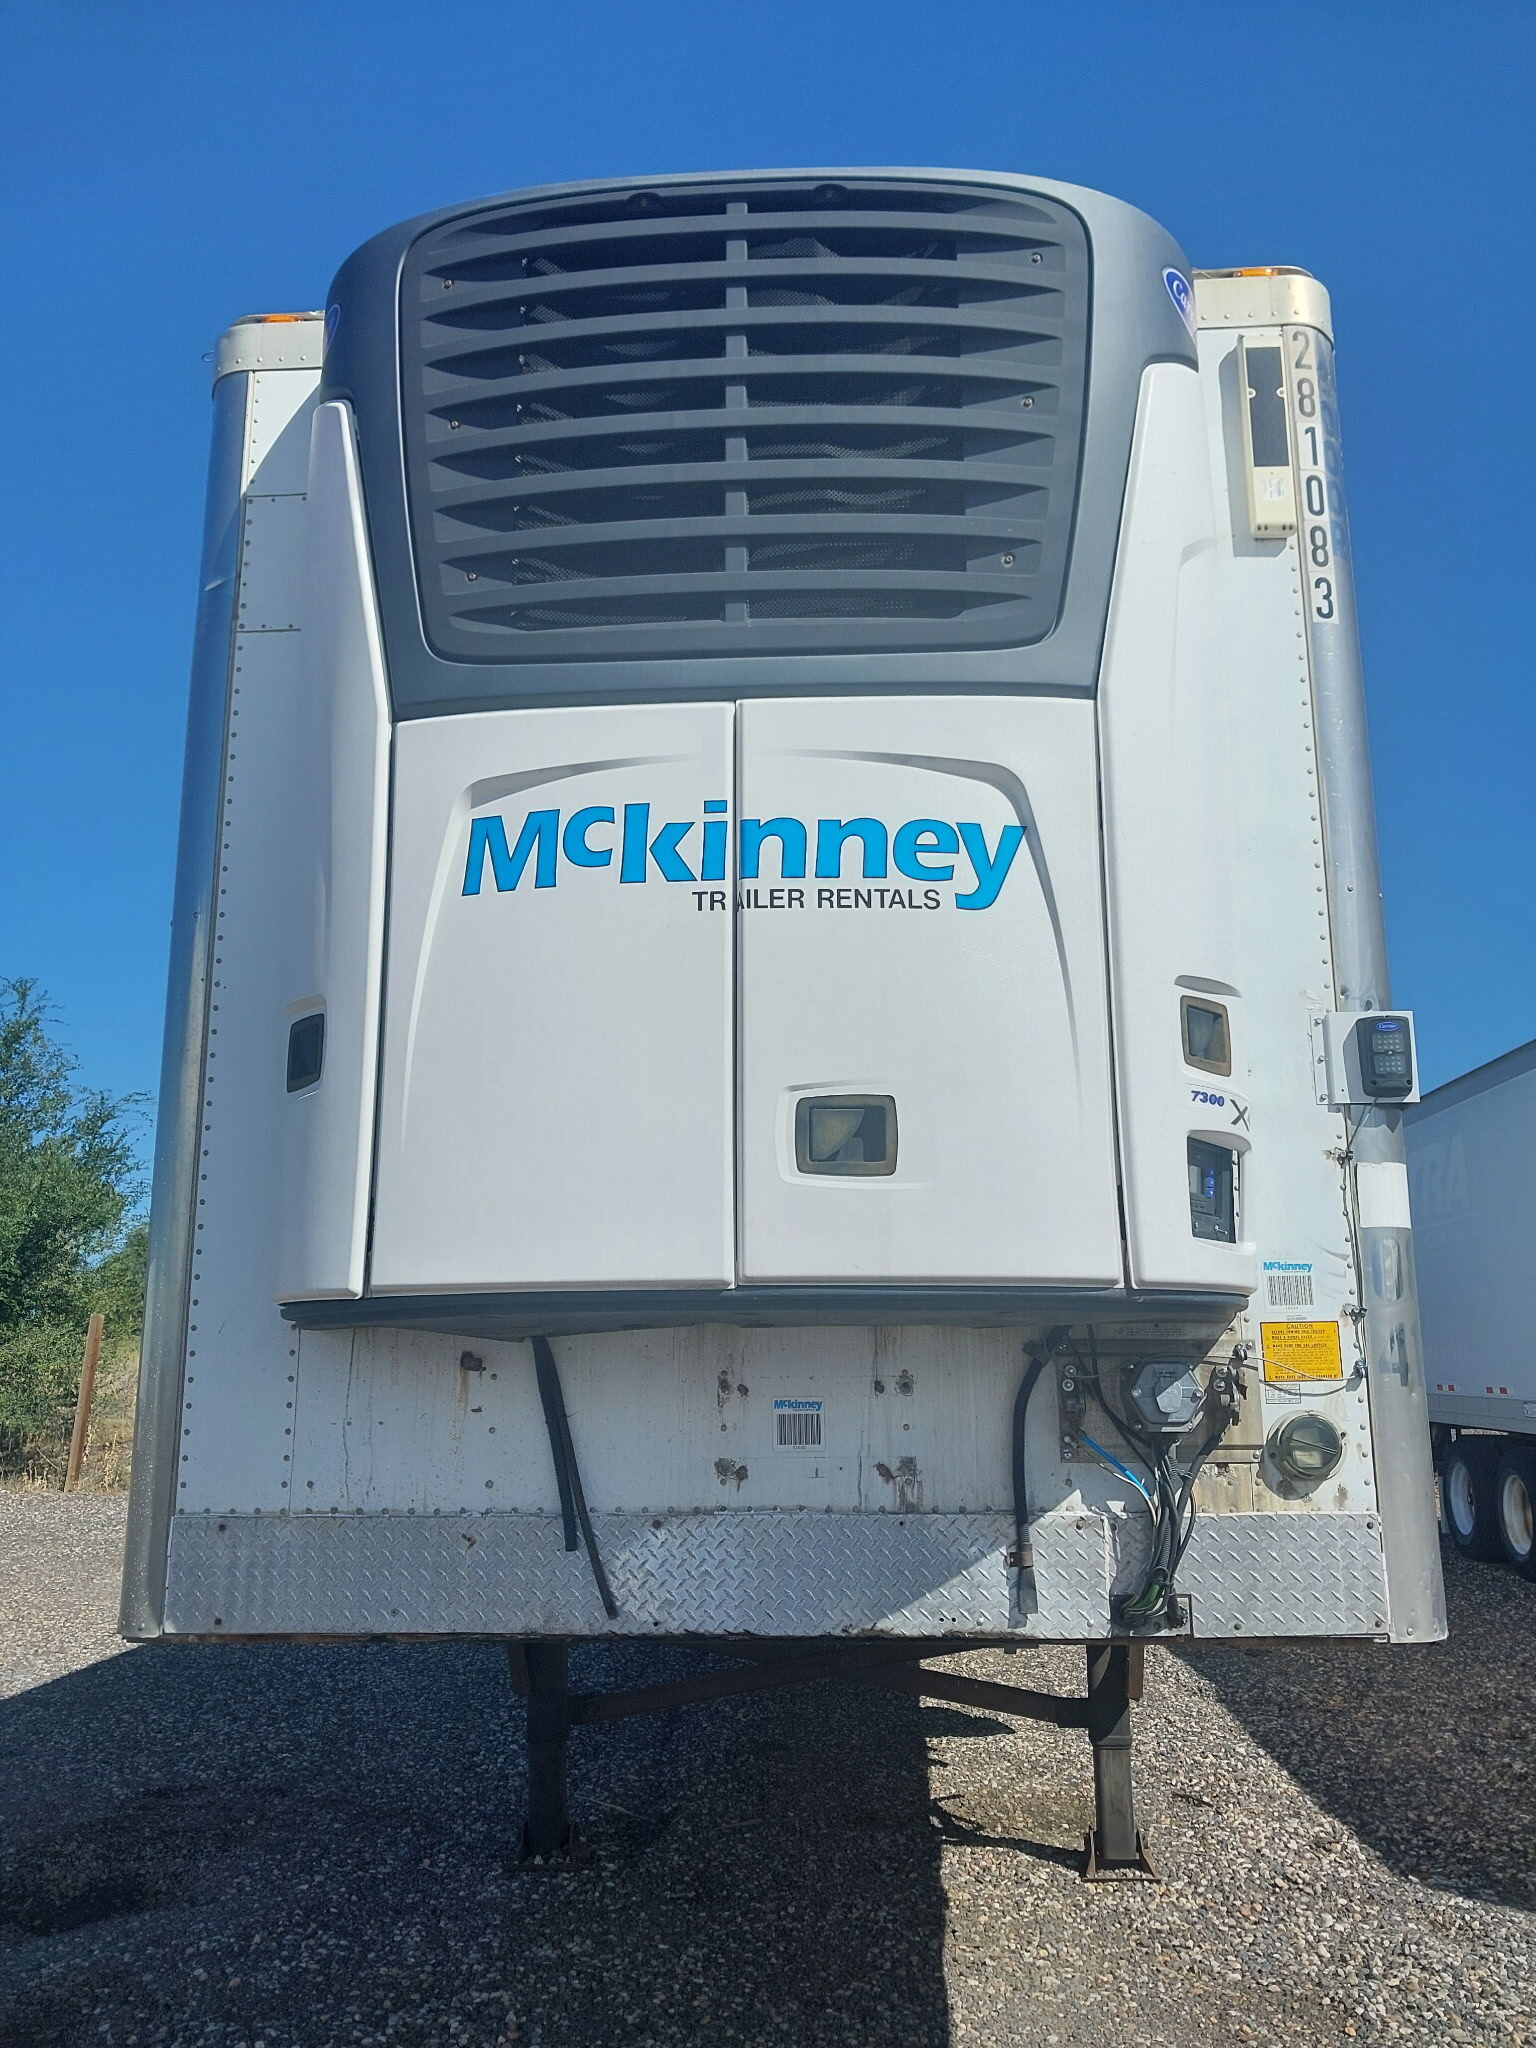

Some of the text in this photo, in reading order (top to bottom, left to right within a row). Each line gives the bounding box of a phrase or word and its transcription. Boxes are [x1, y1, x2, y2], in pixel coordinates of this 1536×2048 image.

[1290, 330, 1335, 620] 281083
[691, 888, 941, 912] TRAILER RENTALS
[1190, 1090, 1226, 1108] 7300
